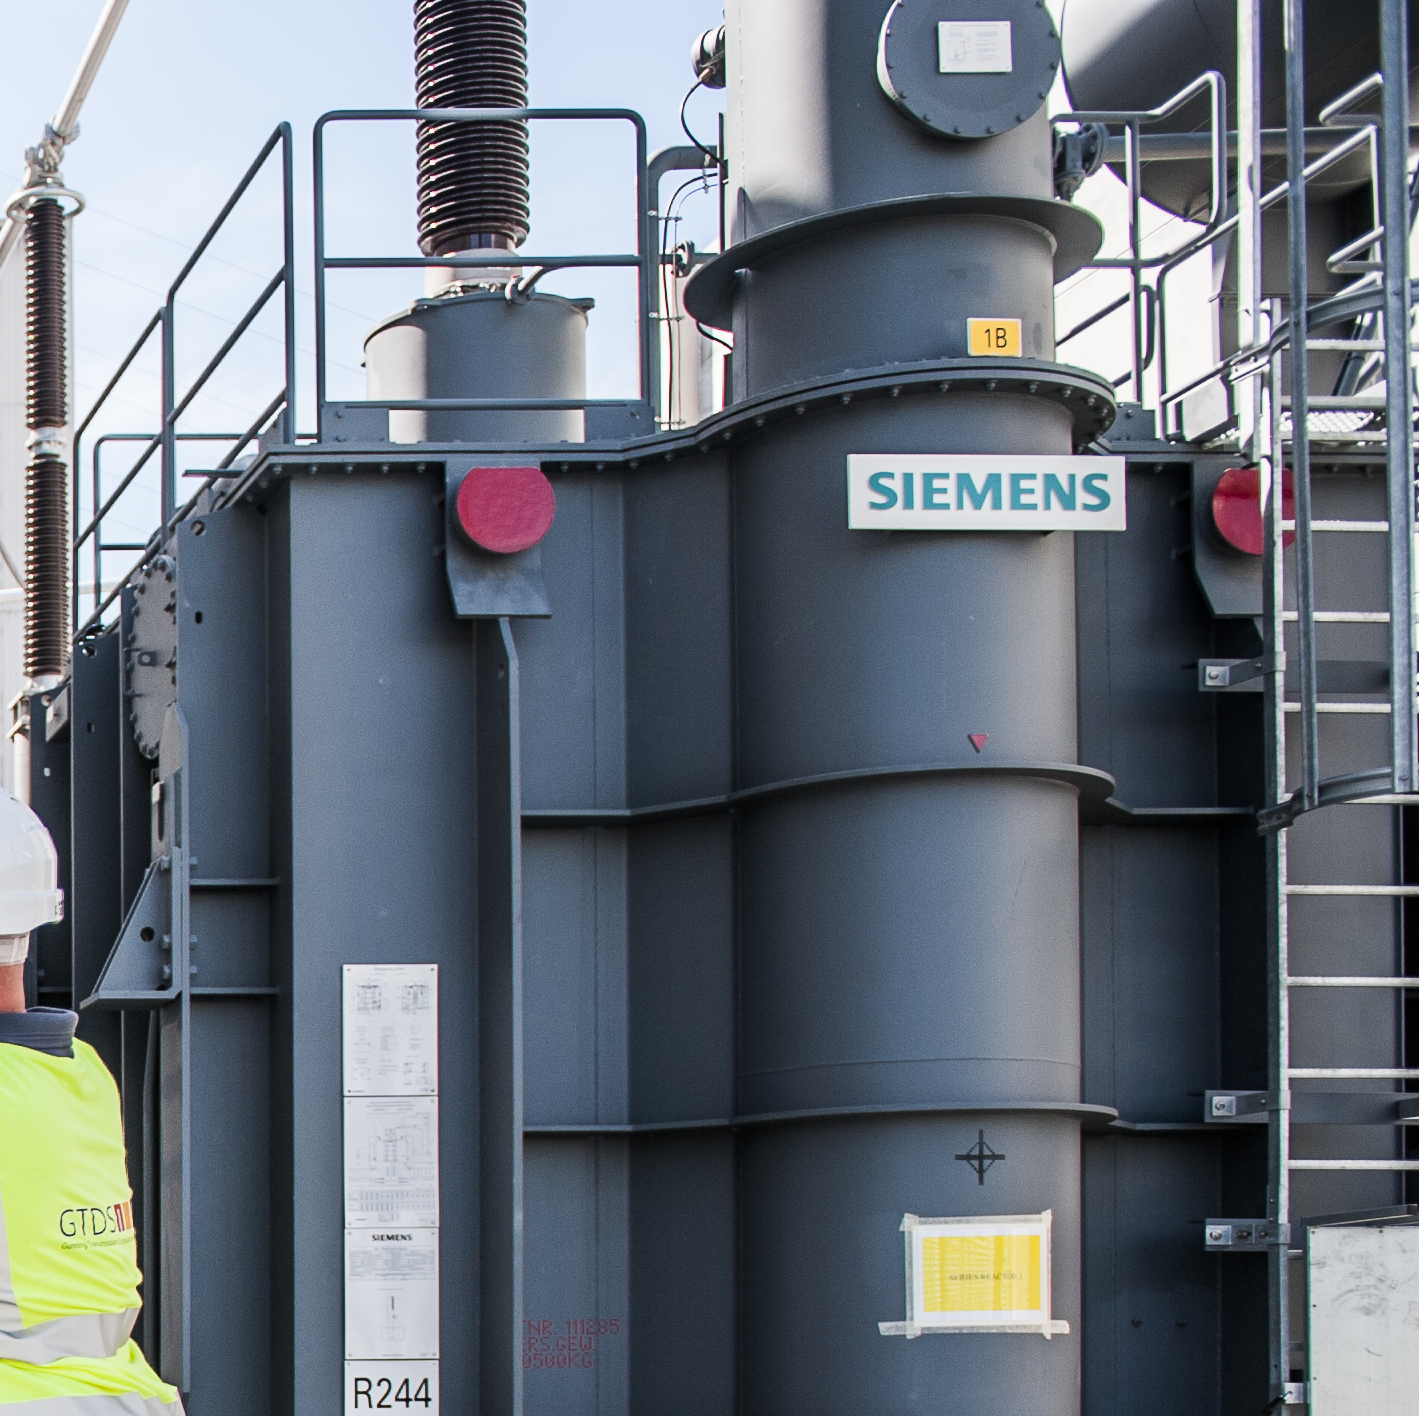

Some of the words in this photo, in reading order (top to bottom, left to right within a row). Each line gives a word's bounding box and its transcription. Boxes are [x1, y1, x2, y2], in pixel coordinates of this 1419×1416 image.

[984, 327, 1008, 351] 1B
[867, 470, 1112, 513] SIEMENS
[59, 1205, 116, 1237] GTDS
[371, 1233, 413, 1242] SIEMENS
[353, 1376, 433, 1409] R244
